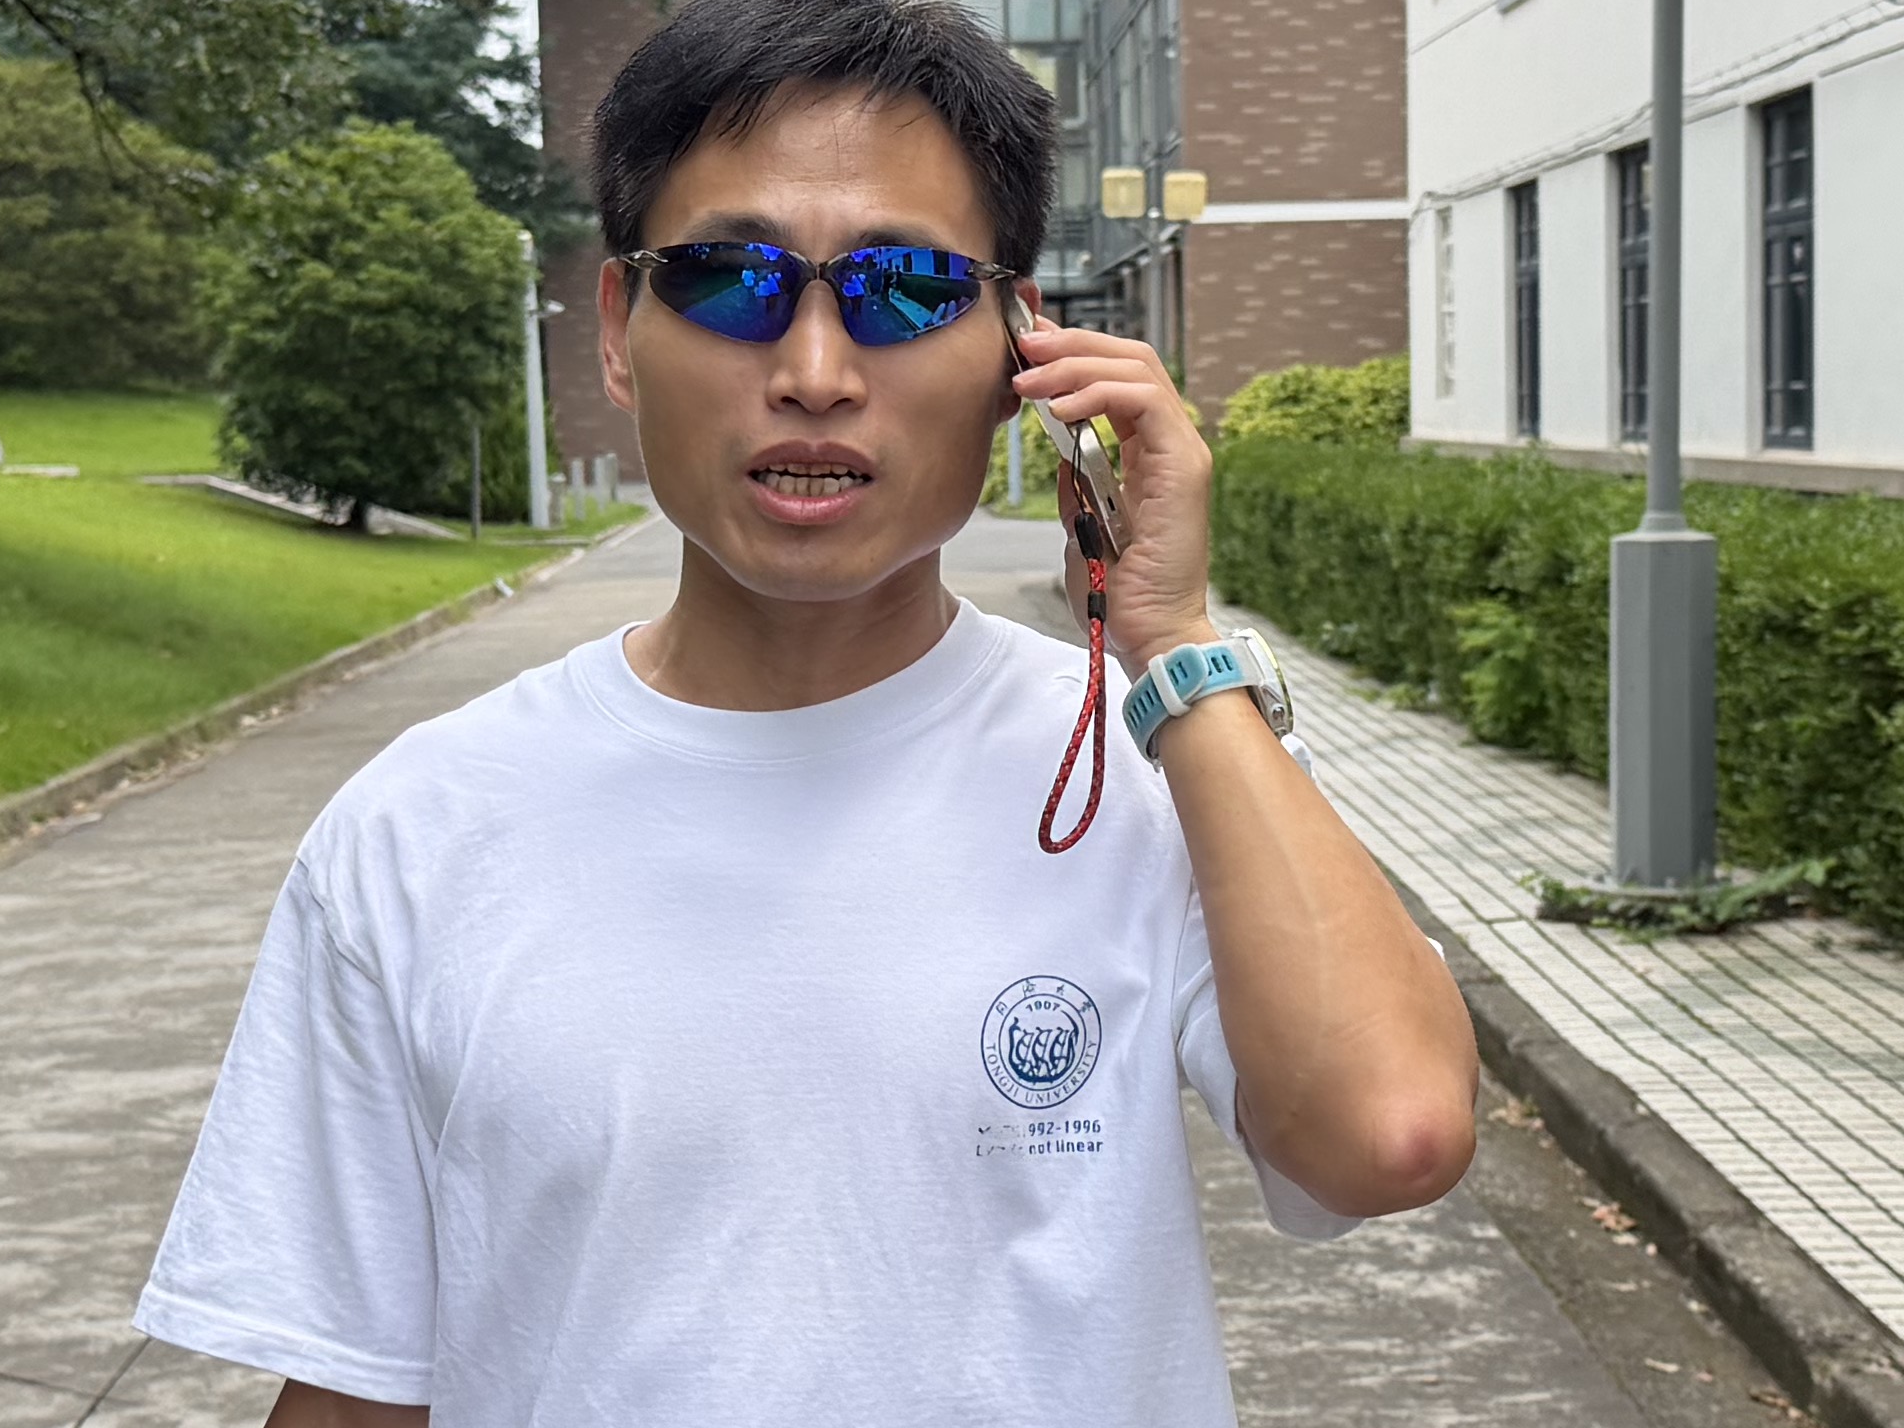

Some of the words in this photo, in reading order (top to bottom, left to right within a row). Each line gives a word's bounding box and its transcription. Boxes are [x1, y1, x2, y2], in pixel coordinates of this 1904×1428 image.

[1025, 1000, 1061, 1013] 1907
[986, 1043, 1020, 1097] TONGJI
[1025, 1040, 1097, 1104] UNIVERSITY
[1028, 1140, 1052, 1155] not
[1056, 1139, 1104, 1153] linear
